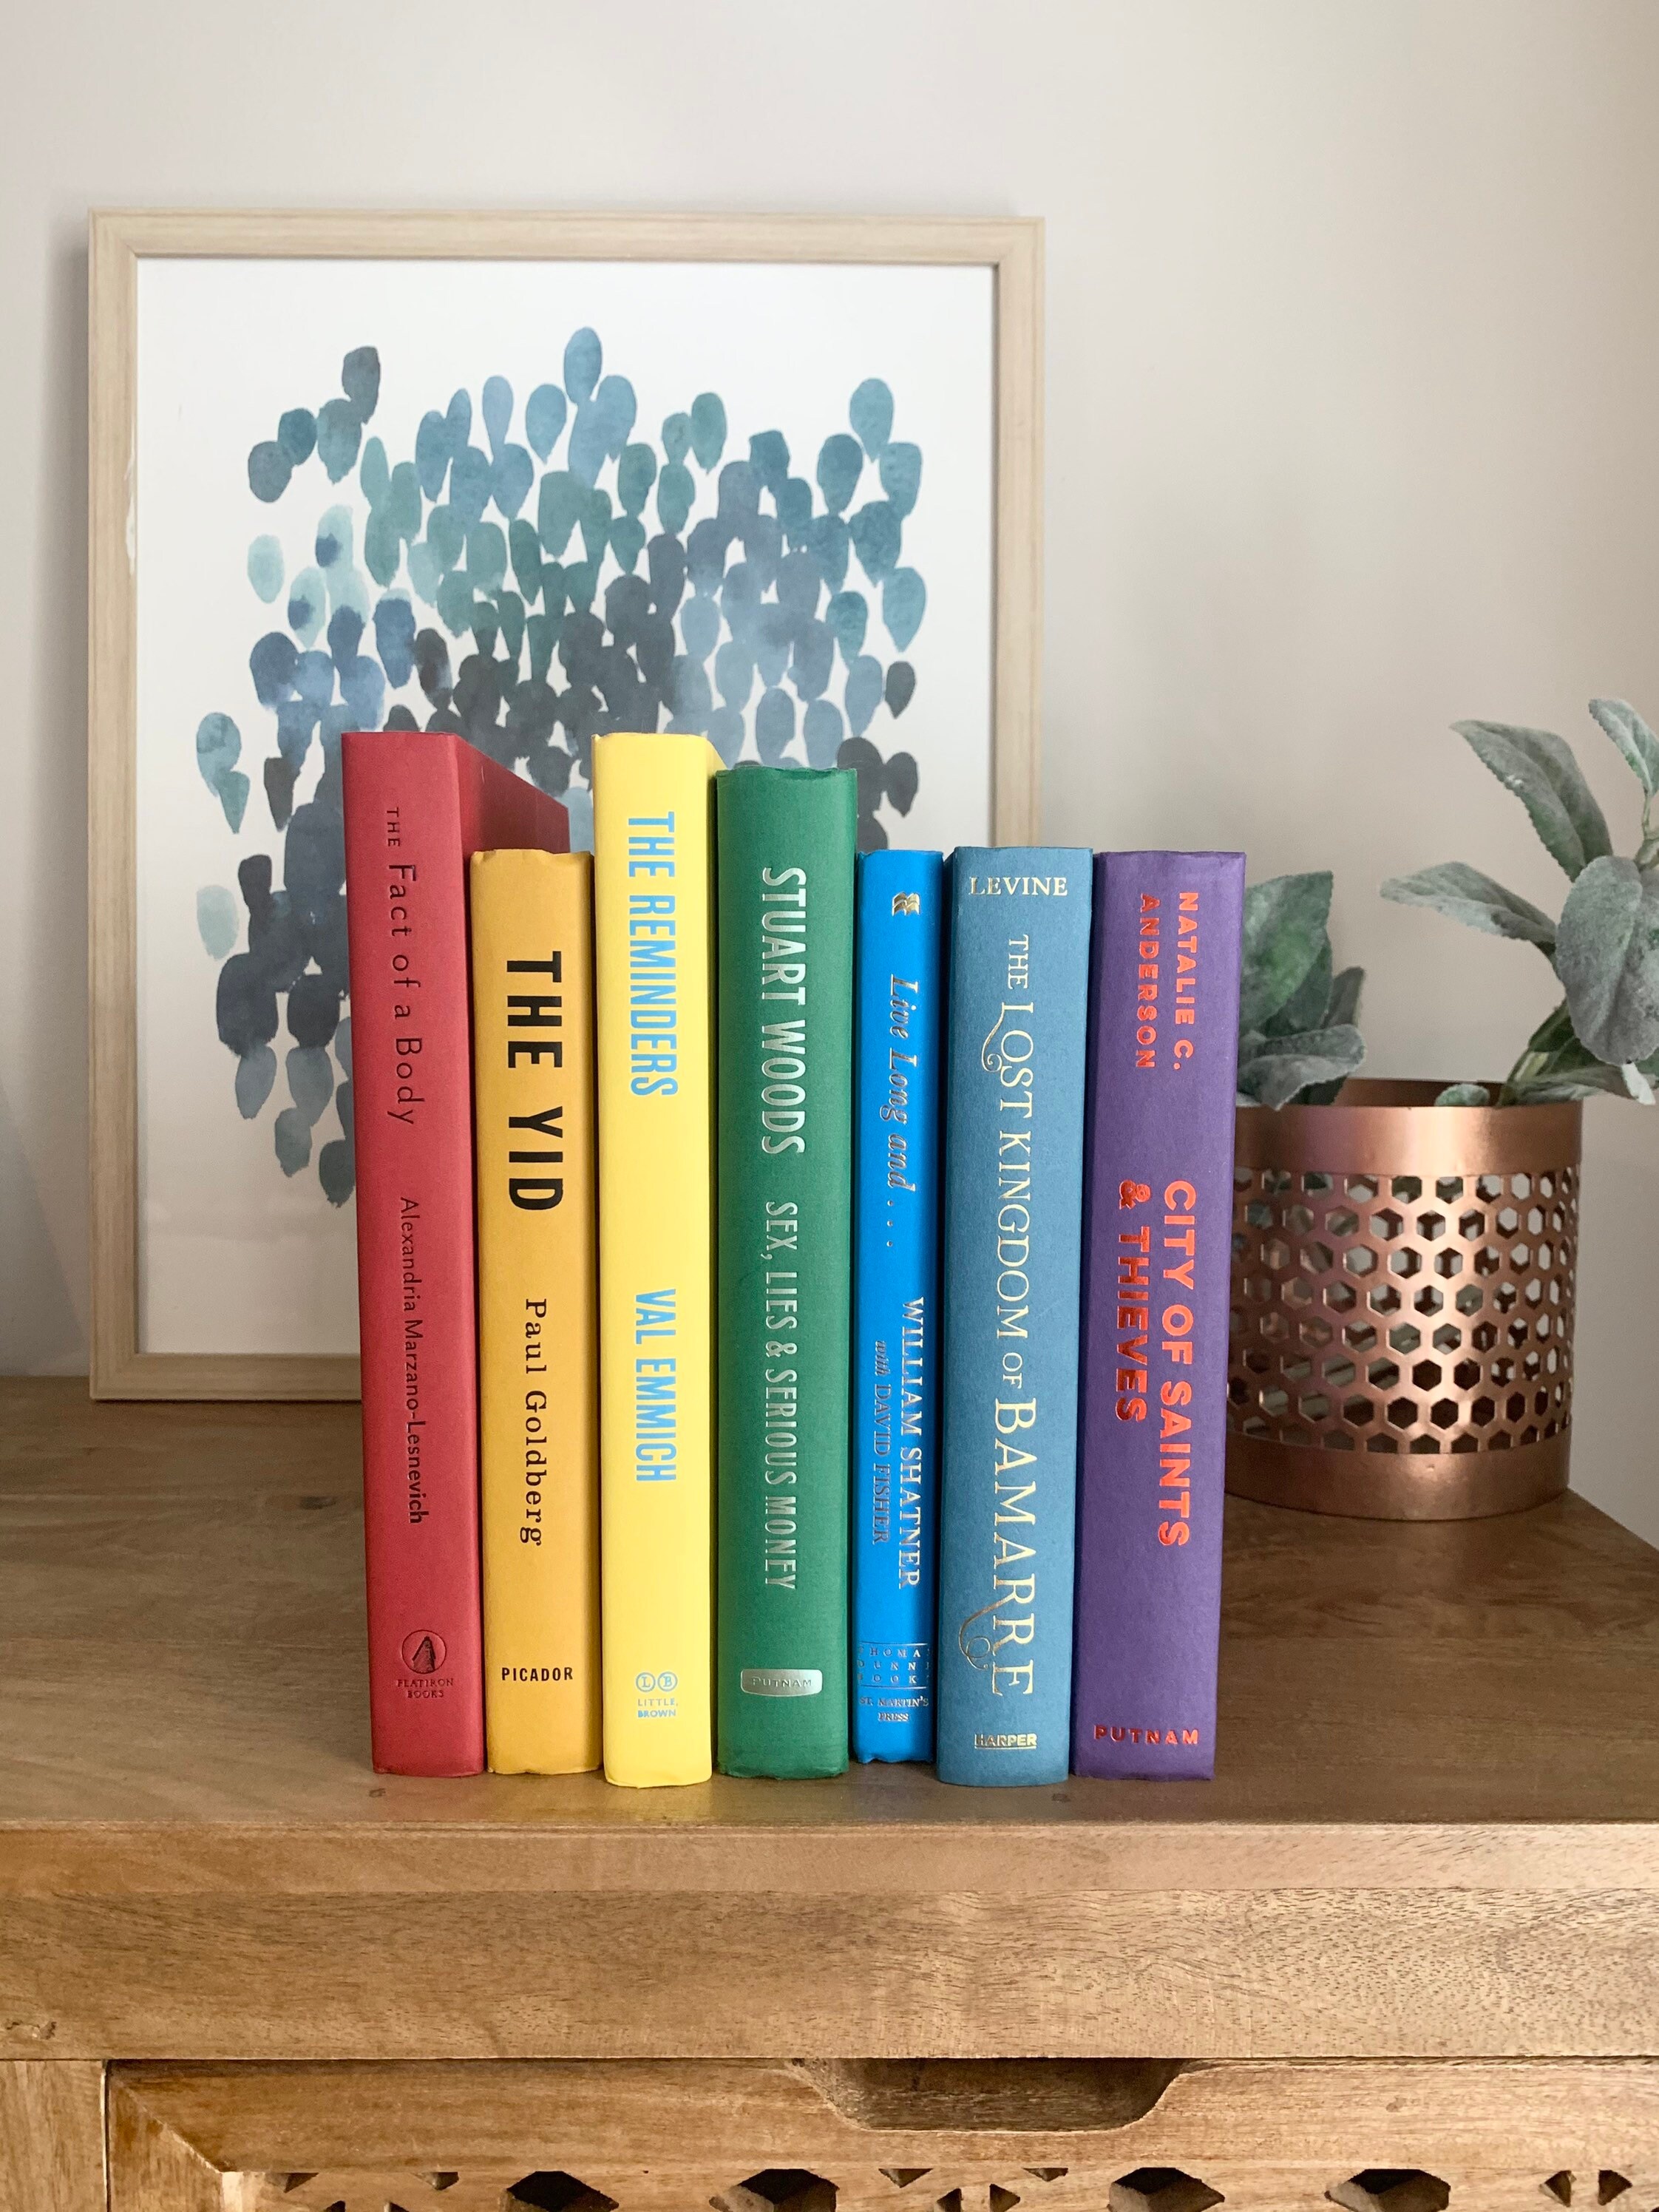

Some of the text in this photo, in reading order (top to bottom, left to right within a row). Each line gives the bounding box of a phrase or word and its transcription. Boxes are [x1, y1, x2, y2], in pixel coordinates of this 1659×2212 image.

[386, 807, 424, 1124] THE Fact of a Body
[628, 811, 679, 1096] THE REMINDERS
[969, 876, 1068, 896] LEVINE
[761, 866, 807, 1155] STUART WOODS
[890, 974, 919, 1039] Live
[1135, 893, 1161, 1068] ANDERSON
[1173, 892, 1198, 1071] NATALIE C.
[506, 951, 563, 1211] THE YID
[880, 1046, 919, 1126] Long
[887, 1133, 916, 1191] and
[400, 1197, 429, 1524] Alexandria Marzano-Lesnevich
[635, 1289, 676, 1482] VAL EMMICH
[959, 934, 1037, 1697] THE LOST KINGDOM OF BAMARRE
[1115, 1180, 1150, 1422] & THIEVES
[1158, 1181, 1196, 1547] CITY OF SAINTS
[519, 1298, 547, 1547] Paul Goldberg
[760, 1201, 799, 1590] SEX, LIES & SERIOUS MONEY
[872, 1339, 892, 1545] with DAVID FISHER
[898, 1296, 925, 1590] WILLIAM SHATNER
[397, 1678, 454, 1688] FLATIRON
[407, 1690, 444, 1699] BOOKS
[501, 1666, 574, 1683] PICADOR
[637, 1697, 679, 1707] LITTLE,
[637, 1709, 676, 1718] BROWN
[750, 1676, 813, 1689] PUTNAM
[860, 1695, 929, 1707] ST. MARTIN'S
[878, 1712, 909, 1722] PRESS
[974, 1733, 1038, 1747] HARPER
[1093, 1724, 1199, 1745] PUTNAM
